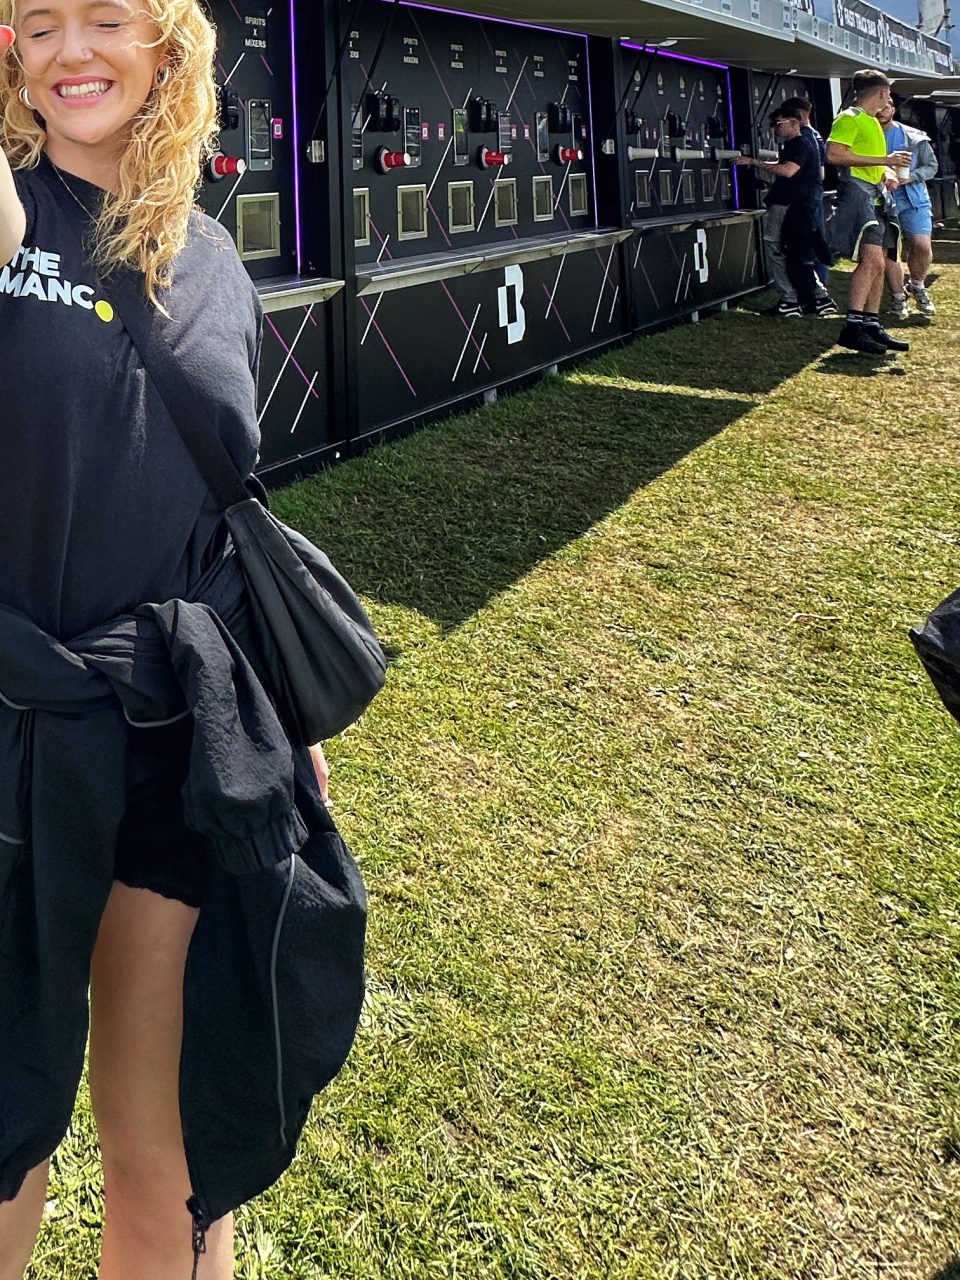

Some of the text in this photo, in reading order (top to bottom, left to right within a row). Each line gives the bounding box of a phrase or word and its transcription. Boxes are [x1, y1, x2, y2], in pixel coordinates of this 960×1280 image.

[245, 16, 266, 26] SPIRITS
[245, 38, 267, 48] MIXERS
[10, 246, 60, 277] THE
